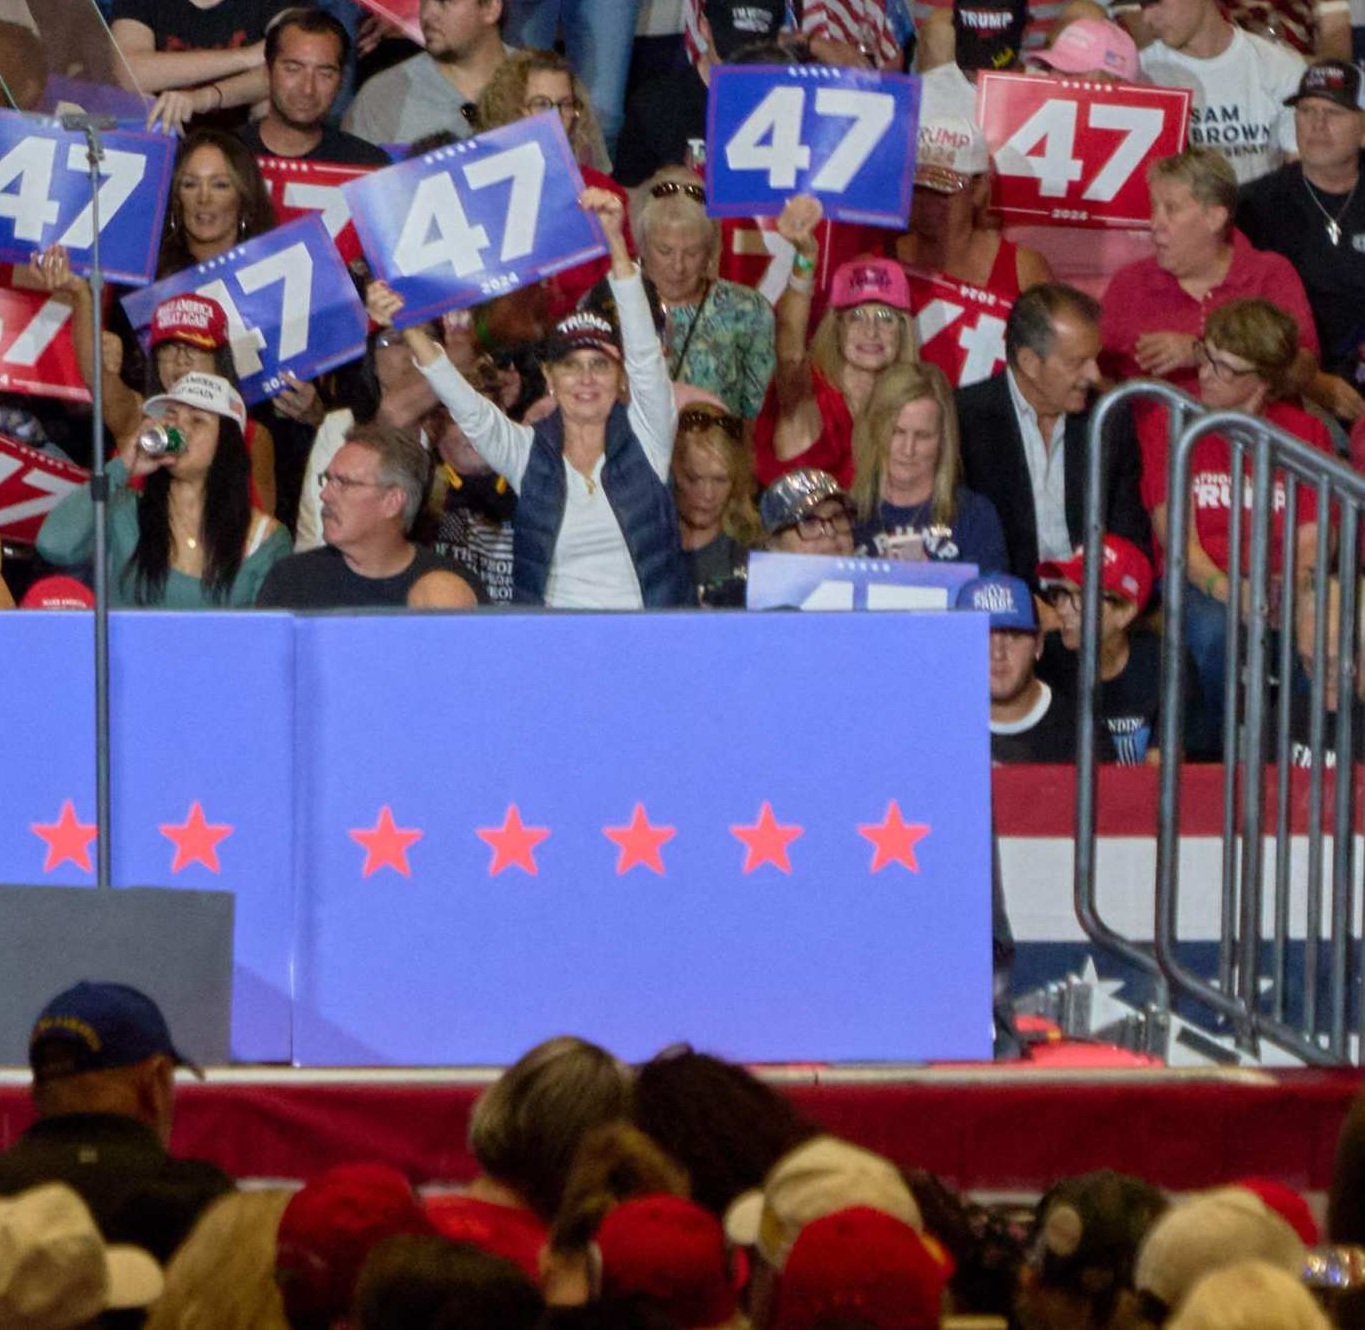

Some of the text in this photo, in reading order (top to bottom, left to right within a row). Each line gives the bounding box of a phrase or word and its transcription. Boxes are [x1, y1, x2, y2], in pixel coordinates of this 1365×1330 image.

[960, 10, 1013, 29] TRUMP
[1191, 104, 1239, 125] SAM
[725, 86, 895, 194] 47
[1192, 127, 1269, 145] BROWN
[995, 99, 1165, 202] 47
[393, 141, 546, 279] 47
[481, 272, 520, 294] 2024
[196, 242, 313, 378] 47
[557, 313, 612, 334] TRUMP
